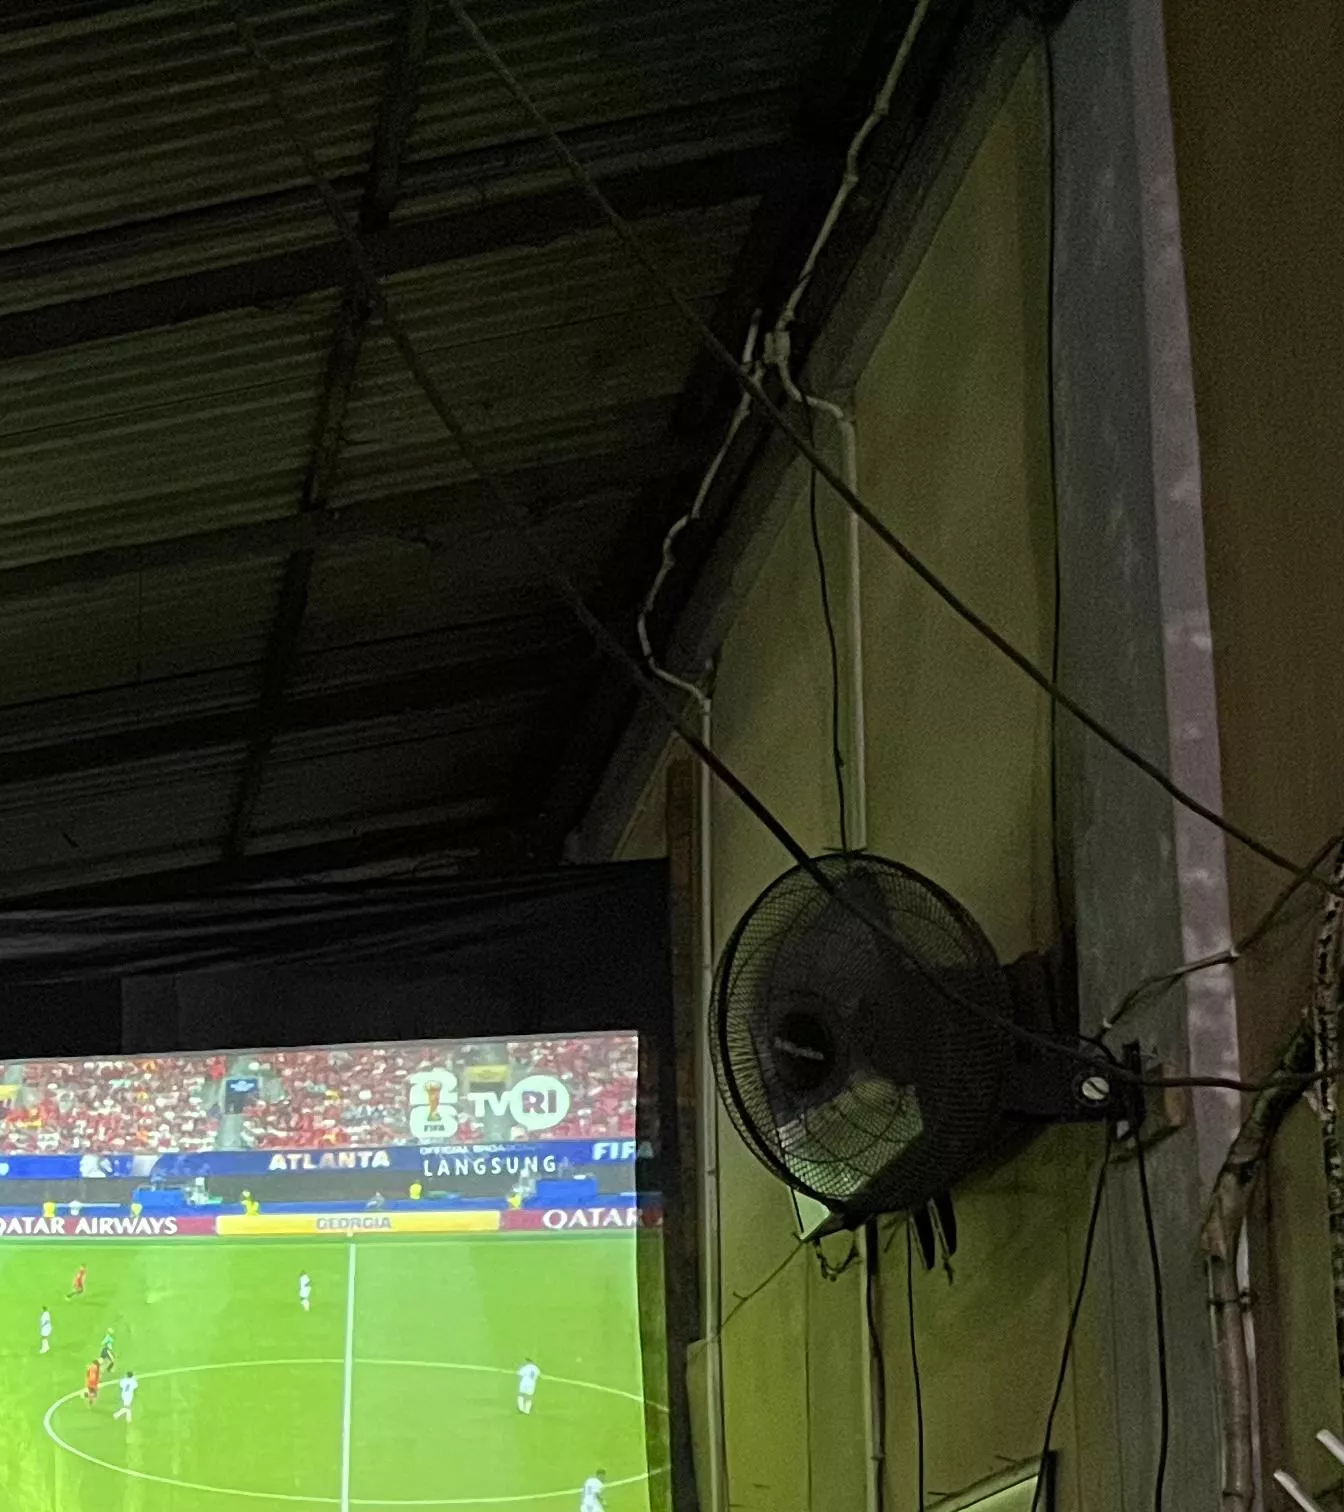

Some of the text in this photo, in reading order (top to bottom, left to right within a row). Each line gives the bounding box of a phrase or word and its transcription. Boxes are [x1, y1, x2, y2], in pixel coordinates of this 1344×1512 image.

[423, 1124, 445, 1132] FIFA
[268, 1150, 390, 1170] ATLANTA
[423, 1155, 556, 1177] LANGSUNG
[75, 1216, 178, 1235] AIRWAYS
[316, 1216, 392, 1230] GEORGIA
[542, 1207, 644, 1229] QATAR
